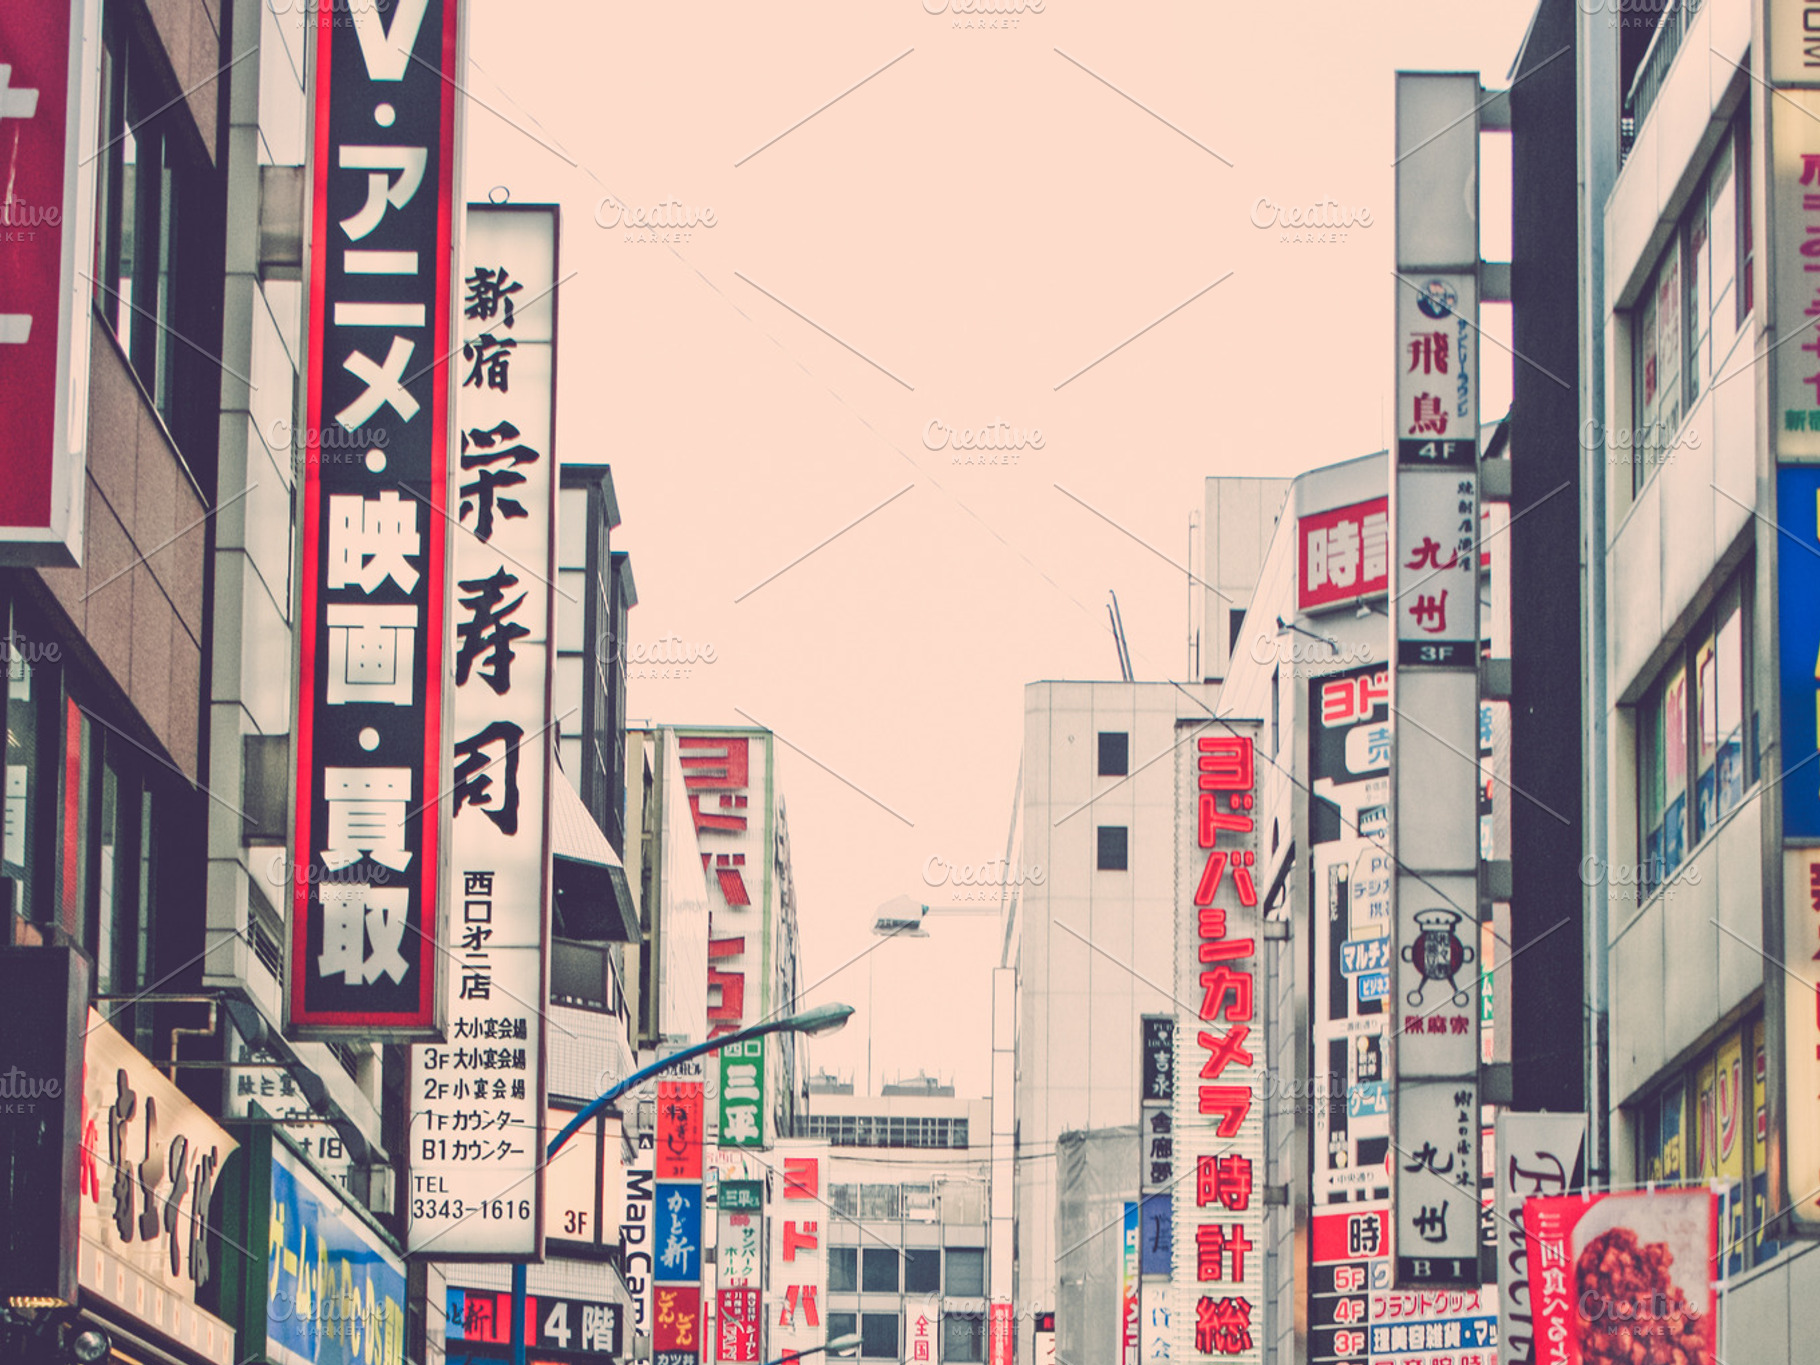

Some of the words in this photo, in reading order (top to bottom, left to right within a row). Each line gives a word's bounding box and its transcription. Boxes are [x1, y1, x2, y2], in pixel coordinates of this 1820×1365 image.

[1408, 331, 1450, 435] 飛鳥
[1418, 440, 1457, 461] 4F
[1420, 645, 1455, 662] 3F
[454, 1017, 528, 1041] 大小宴会場
[424, 1048, 449, 1070] 3F
[453, 1047, 527, 1072] 大小宴会場
[424, 1079, 449, 1099] 2F
[453, 1078, 526, 1101] 小宴会場
[723, 1064, 761, 1142] 三平
[426, 1109, 449, 1131] 1F
[452, 1109, 526, 1132] カウンター
[422, 1139, 447, 1161] B1
[451, 1138, 525, 1163] カウンター
[415, 1176, 449, 1194] TEL
[413, 1200, 531, 1220] 3343-1616
[564, 1210, 588, 1236] 3F
[1335, 1267, 1365, 1292] 5F
[1334, 1298, 1365, 1323] 4F
[543, 1302, 616, 1353] 4階
[1334, 1330, 1365, 1354] 3F
